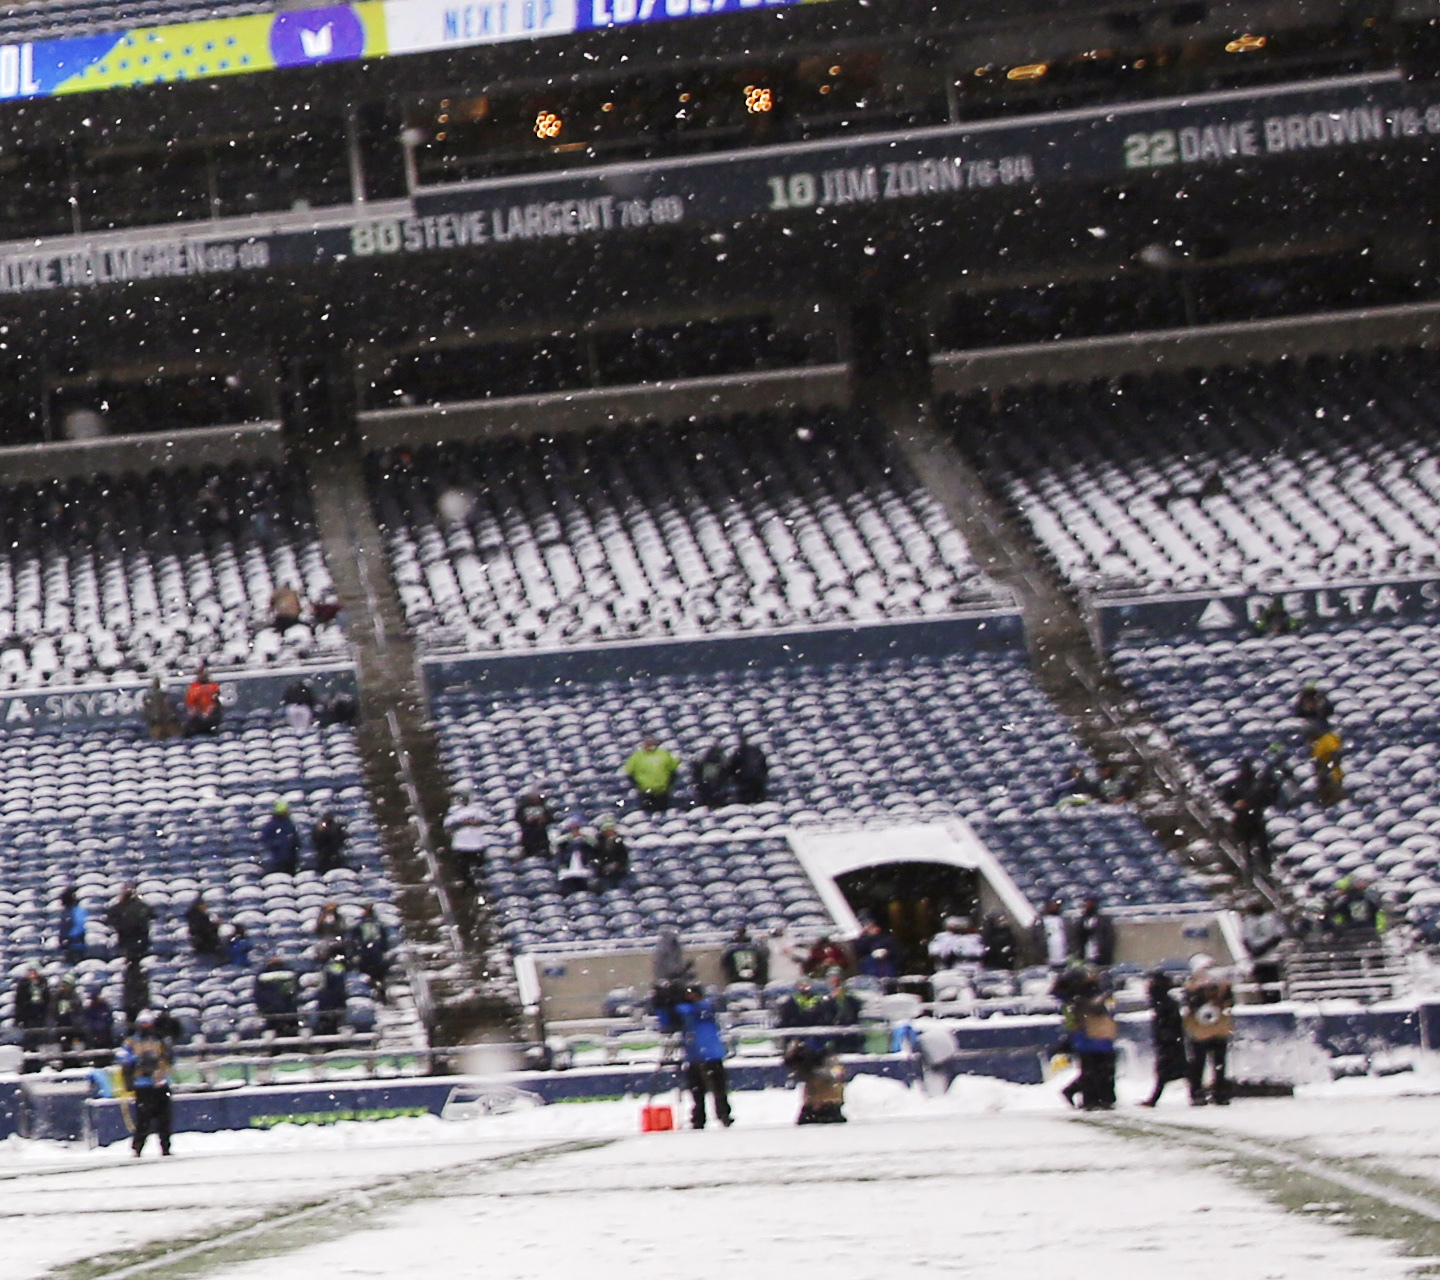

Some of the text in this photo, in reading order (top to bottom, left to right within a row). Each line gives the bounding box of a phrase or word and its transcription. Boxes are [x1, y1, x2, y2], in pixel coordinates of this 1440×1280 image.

[442, 2, 512, 43] NEXT
[1123, 129, 1178, 169] 22
[1179, 119, 1260, 164] DAVE
[1263, 105, 1382, 153] BROWN
[766, 172, 817, 210] 10
[821, 165, 879, 206] JIM
[882, 156, 965, 200] ZORN
[351, 221, 402, 257] 80
[403, 210, 489, 253] STEVE
[491, 196, 615, 243] LARGENT
[59, 240, 206, 287] HOLMGREN
